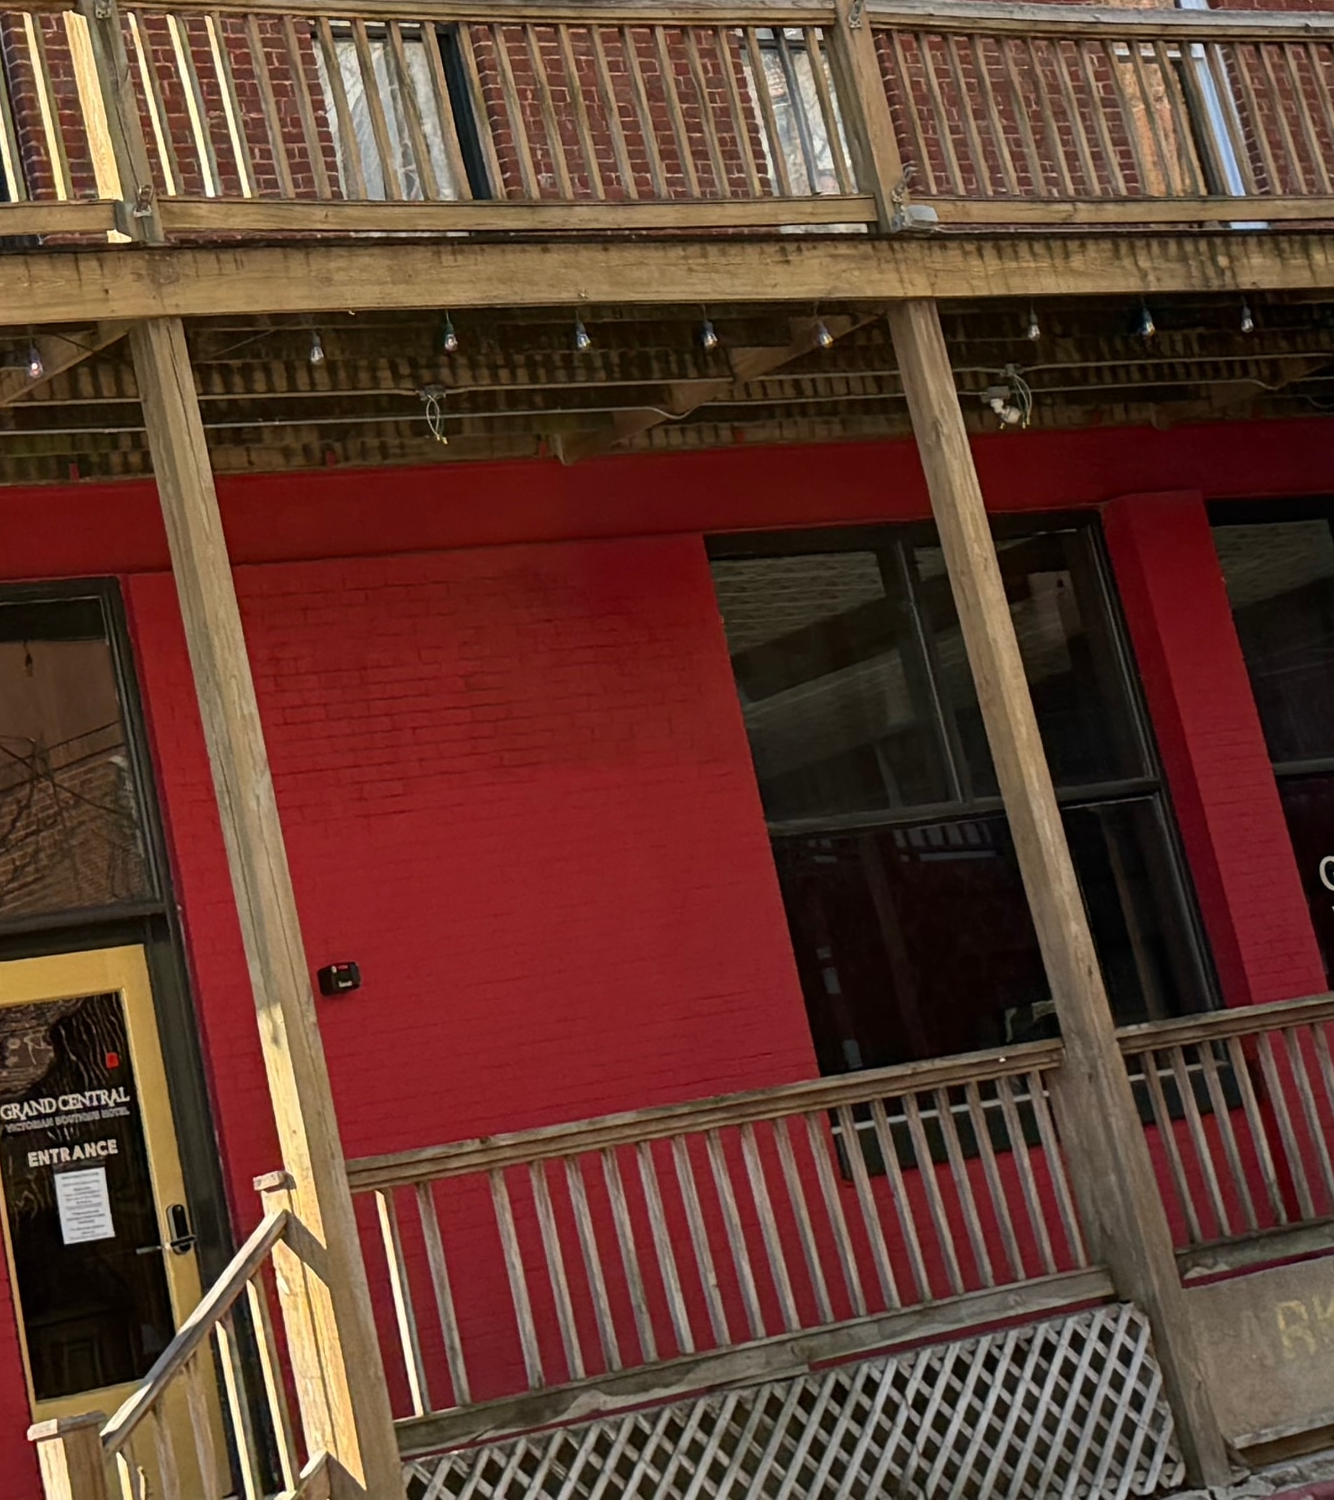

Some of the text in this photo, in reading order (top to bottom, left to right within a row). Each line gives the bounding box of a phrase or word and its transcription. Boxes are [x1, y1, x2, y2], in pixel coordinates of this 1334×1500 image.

[0, 1086, 130, 1120] GRAND CENTRAL
[27, 1139, 119, 1168] ENTRANCE
